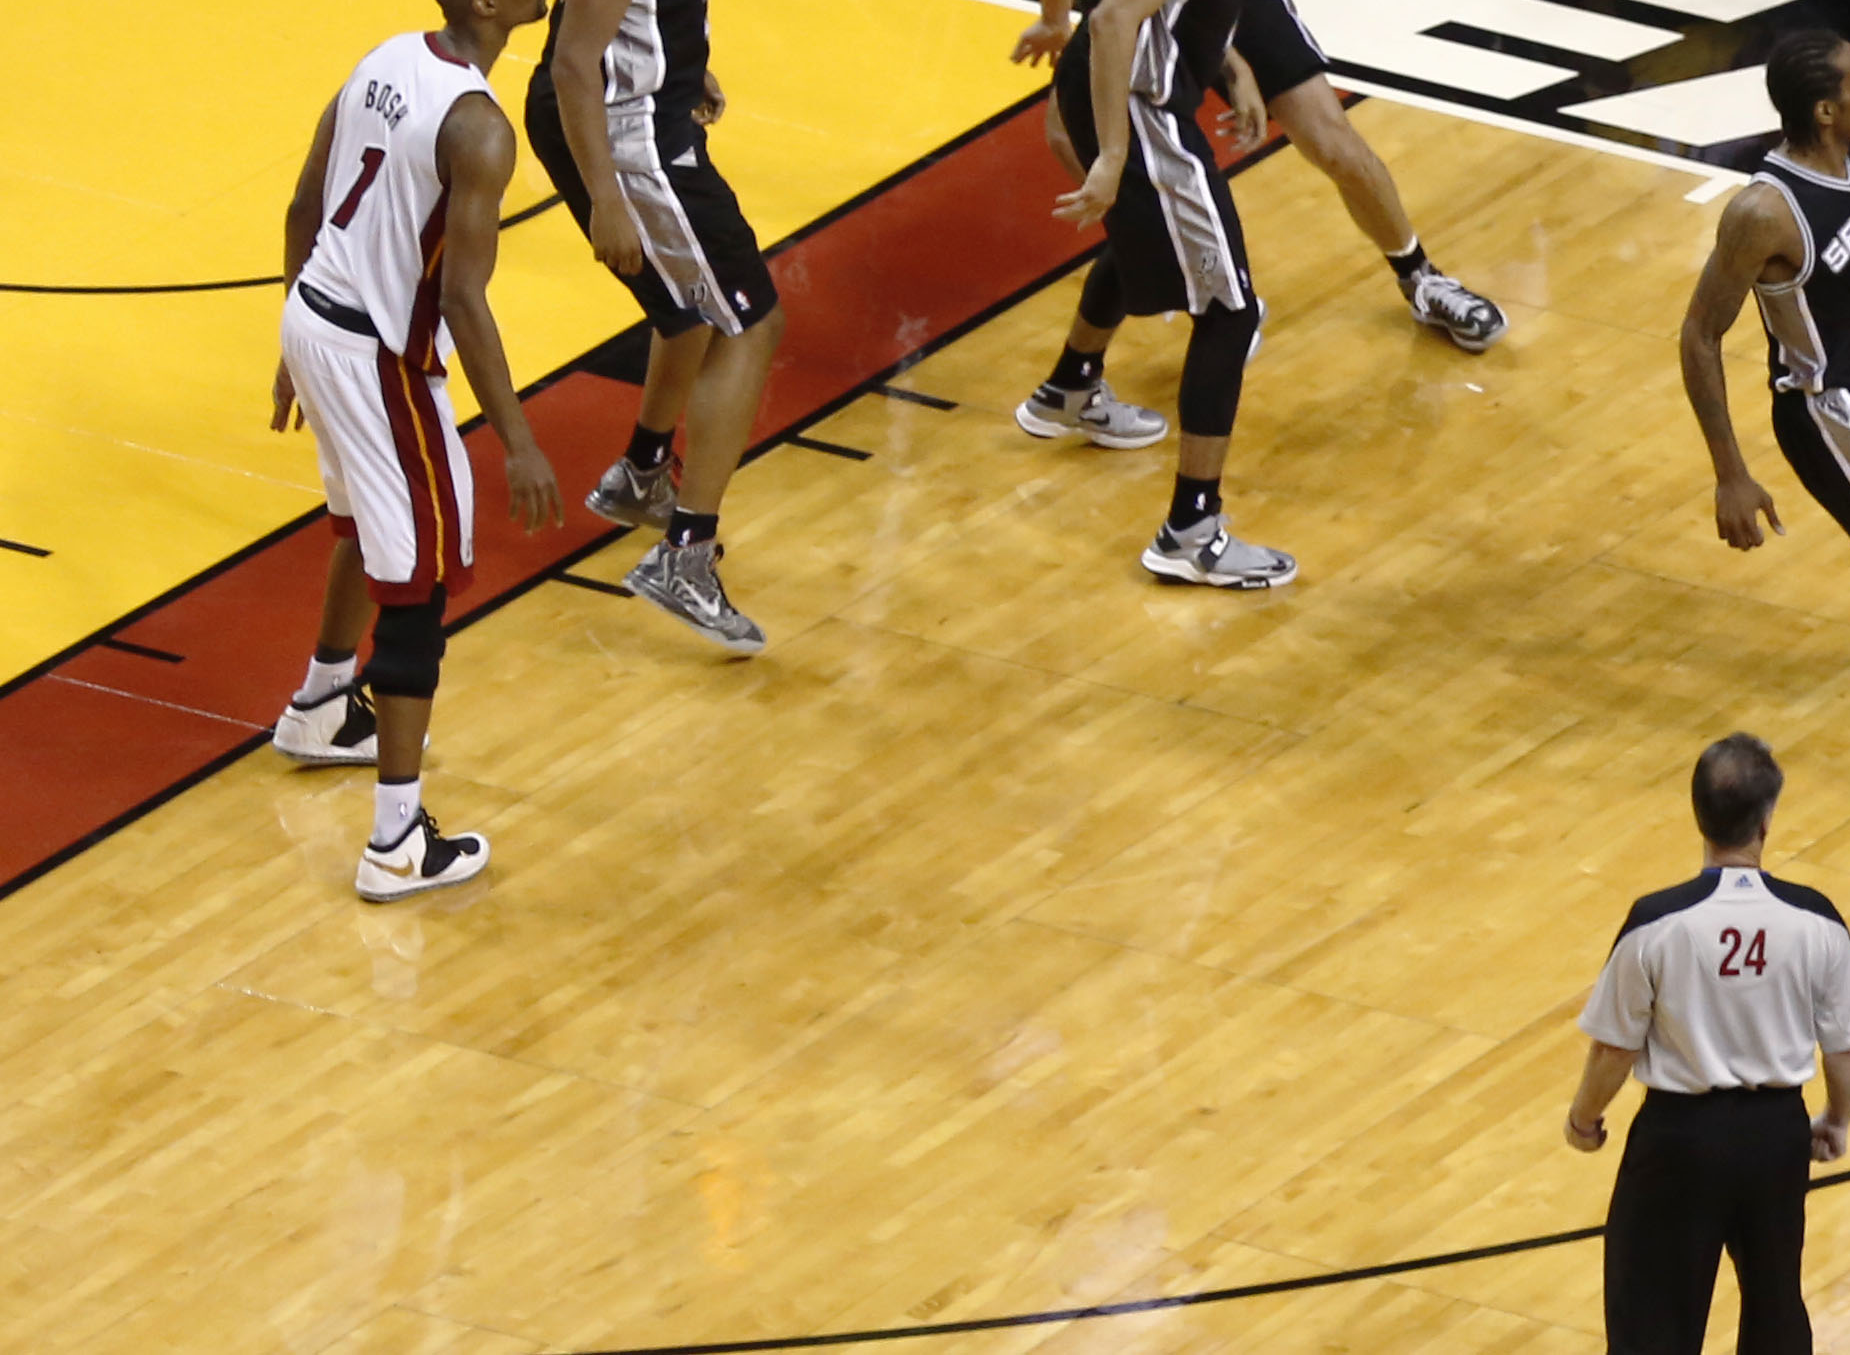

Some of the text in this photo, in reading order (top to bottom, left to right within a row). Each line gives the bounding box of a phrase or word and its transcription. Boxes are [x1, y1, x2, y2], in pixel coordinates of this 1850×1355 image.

[366, 80, 409, 133] BOSH
[330, 147, 386, 230] 1
[1718, 928, 1767, 977] 24
